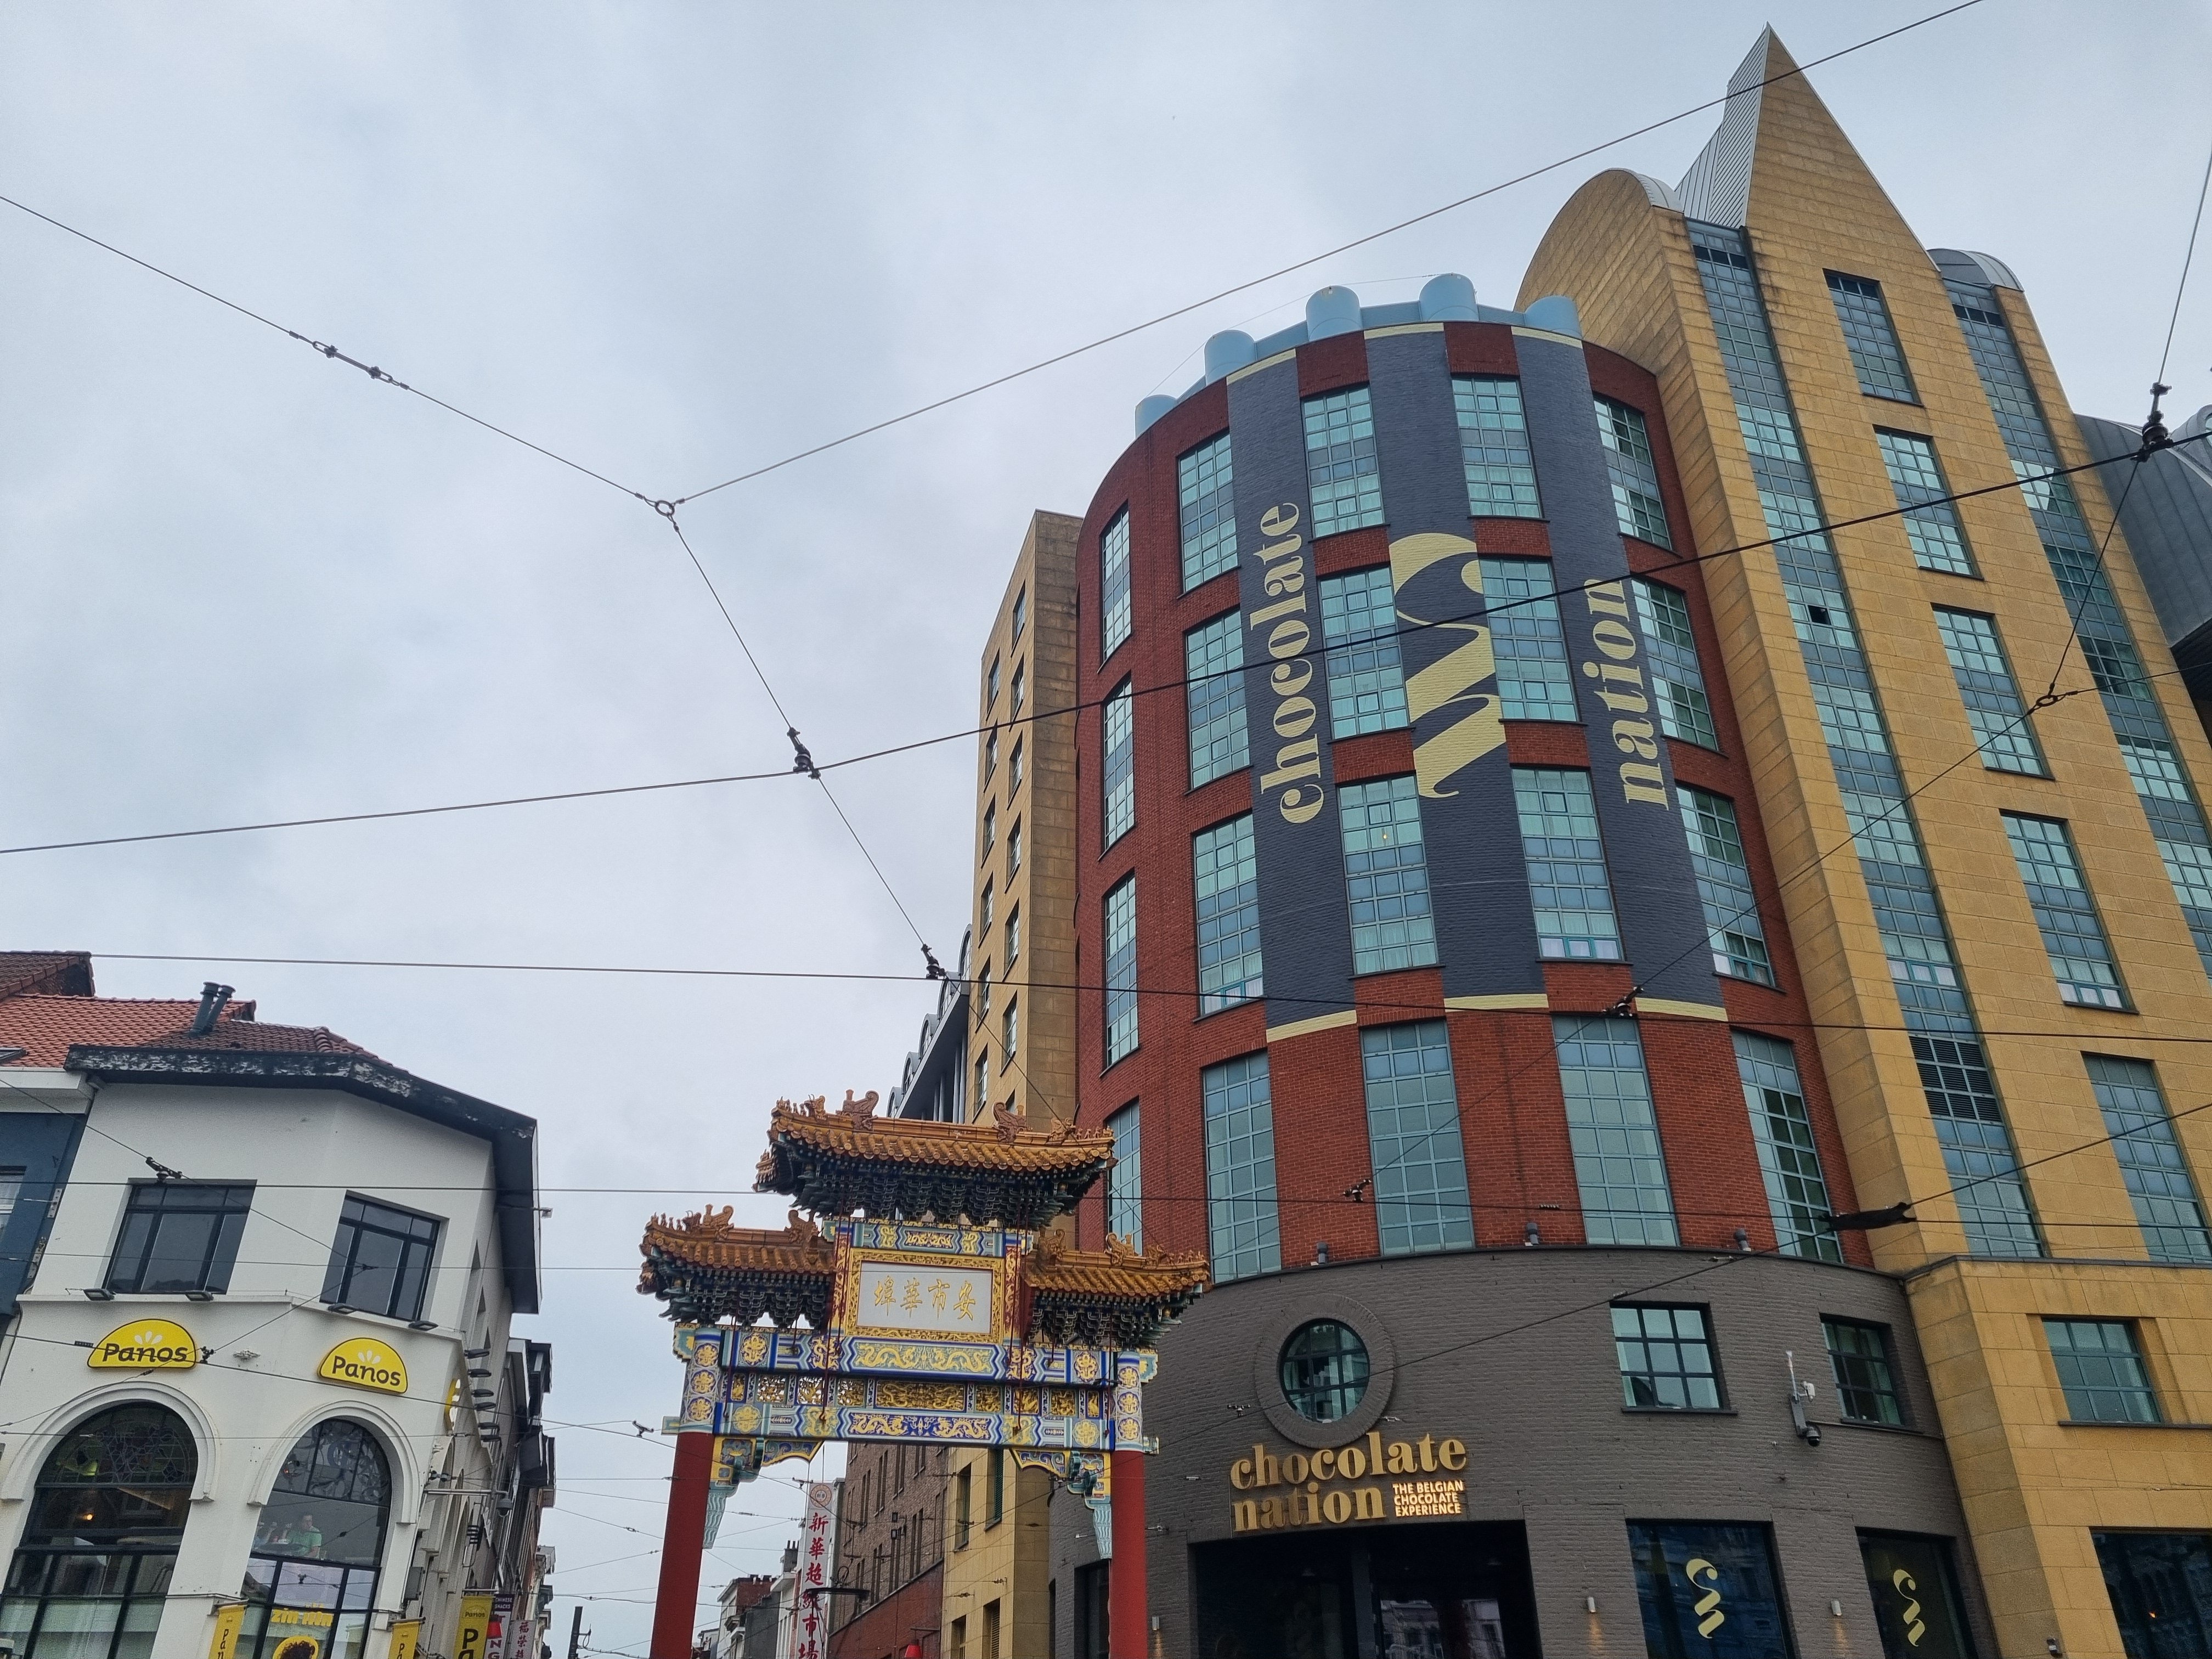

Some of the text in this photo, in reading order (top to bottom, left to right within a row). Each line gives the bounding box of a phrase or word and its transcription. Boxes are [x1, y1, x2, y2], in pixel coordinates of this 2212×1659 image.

[1250, 503, 1324, 823] chocolate
[1583, 579, 1669, 810] nation
[102, 1343, 188, 1363] Panos
[332, 1355, 401, 1386] Panos
[1230, 1431, 1467, 1490] chocolate
[1392, 1480, 1464, 1495] THE BELGIAN
[1394, 1492, 1459, 1506] CHOCOLATE
[1233, 1482, 1387, 1532] nation
[1395, 1503, 1462, 1517] EXPERIENCE
